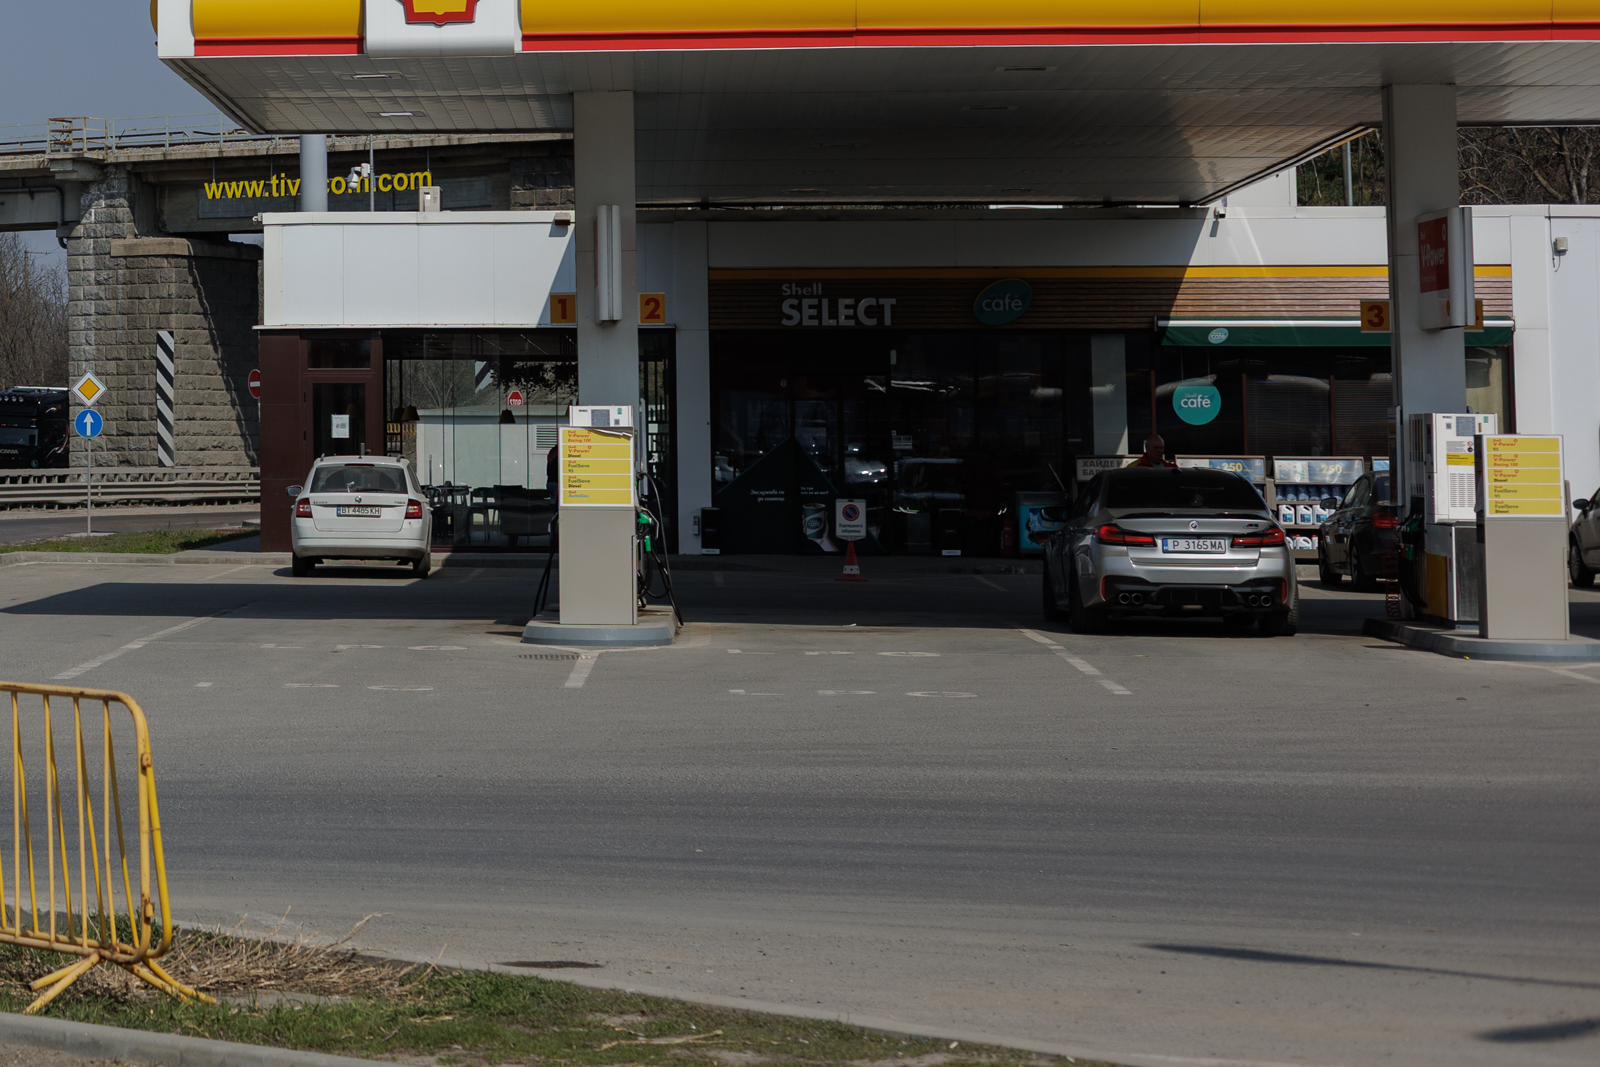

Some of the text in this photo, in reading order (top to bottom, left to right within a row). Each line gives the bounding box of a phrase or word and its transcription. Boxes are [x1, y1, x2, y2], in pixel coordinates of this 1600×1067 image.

[1420, 244, 1445, 268] V-Power
[781, 282, 822, 296] Shell
[557, 298, 567, 320] 1
[644, 297, 661, 320] 2
[781, 297, 897, 327] SELECT
[982, 293, 1022, 311] café
[1367, 304, 1384, 327] 3
[1180, 394, 1211, 408] café
